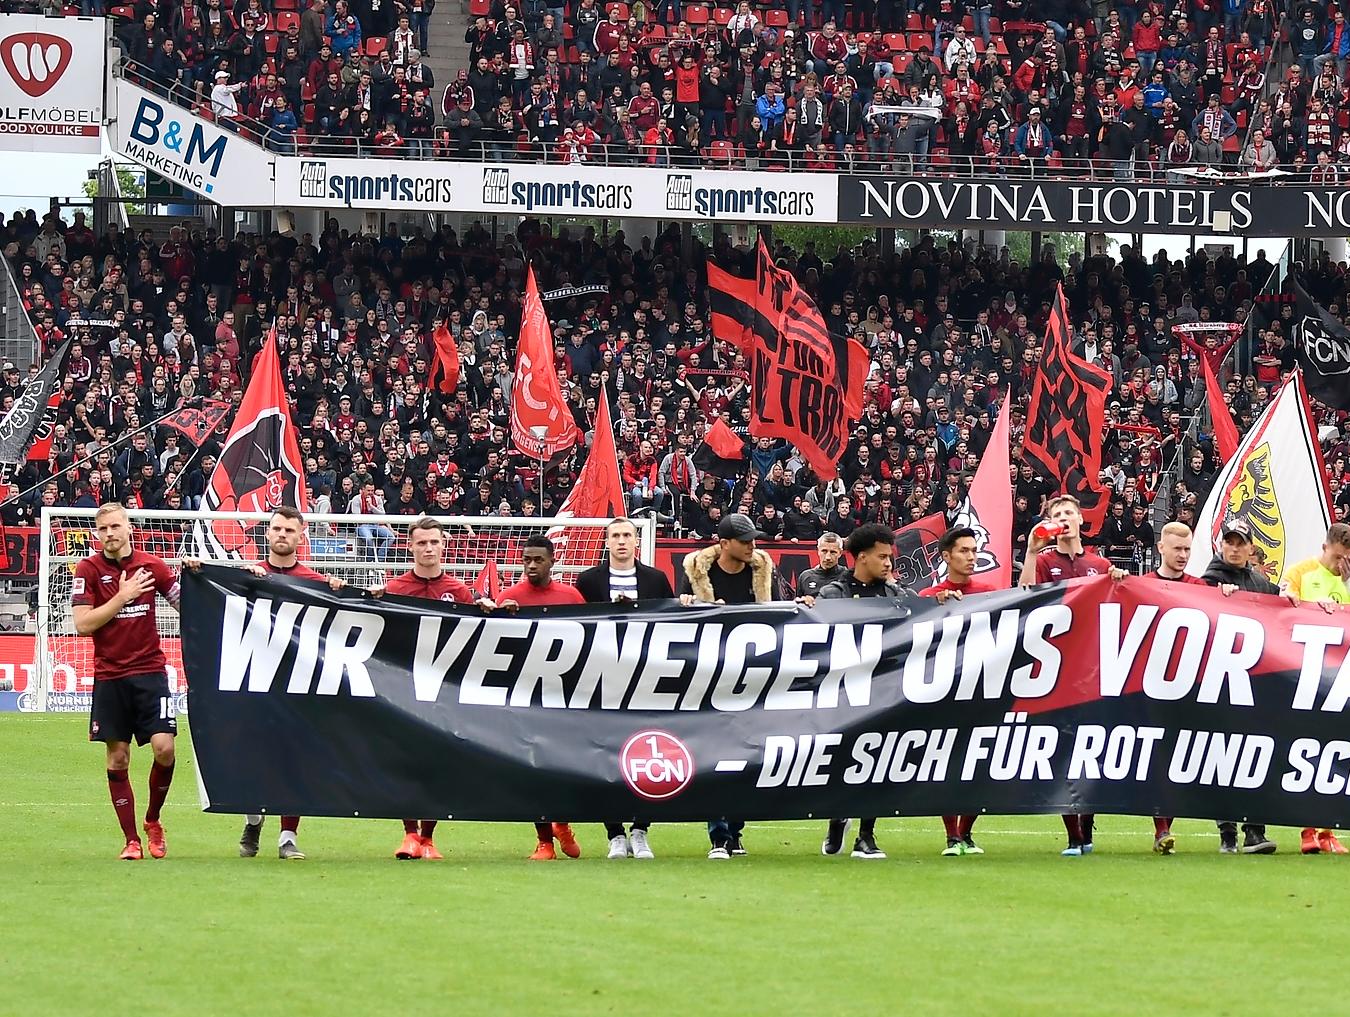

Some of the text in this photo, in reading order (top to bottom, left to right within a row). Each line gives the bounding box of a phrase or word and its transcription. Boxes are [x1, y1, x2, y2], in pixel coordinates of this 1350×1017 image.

[130, 97, 228, 178] B&M
[125, 141, 203, 188] MARKETING
[859, 180, 1252, 230] NOVINA HOTELS
[218, 595, 386, 698] WIR
[413, 615, 883, 712] VERNEIGEN
[901, 603, 1073, 704] UNS
[1099, 602, 1265, 707] VOR
[160, 697, 175, 719] 18
[630, 757, 686, 783] FCN
[756, 733, 842, 788] DIE
[843, 728, 958, 784] SICH
[960, 711, 1062, 781] FÜR
[1067, 724, 1165, 782] ROT
[1169, 730, 1276, 790] UND
